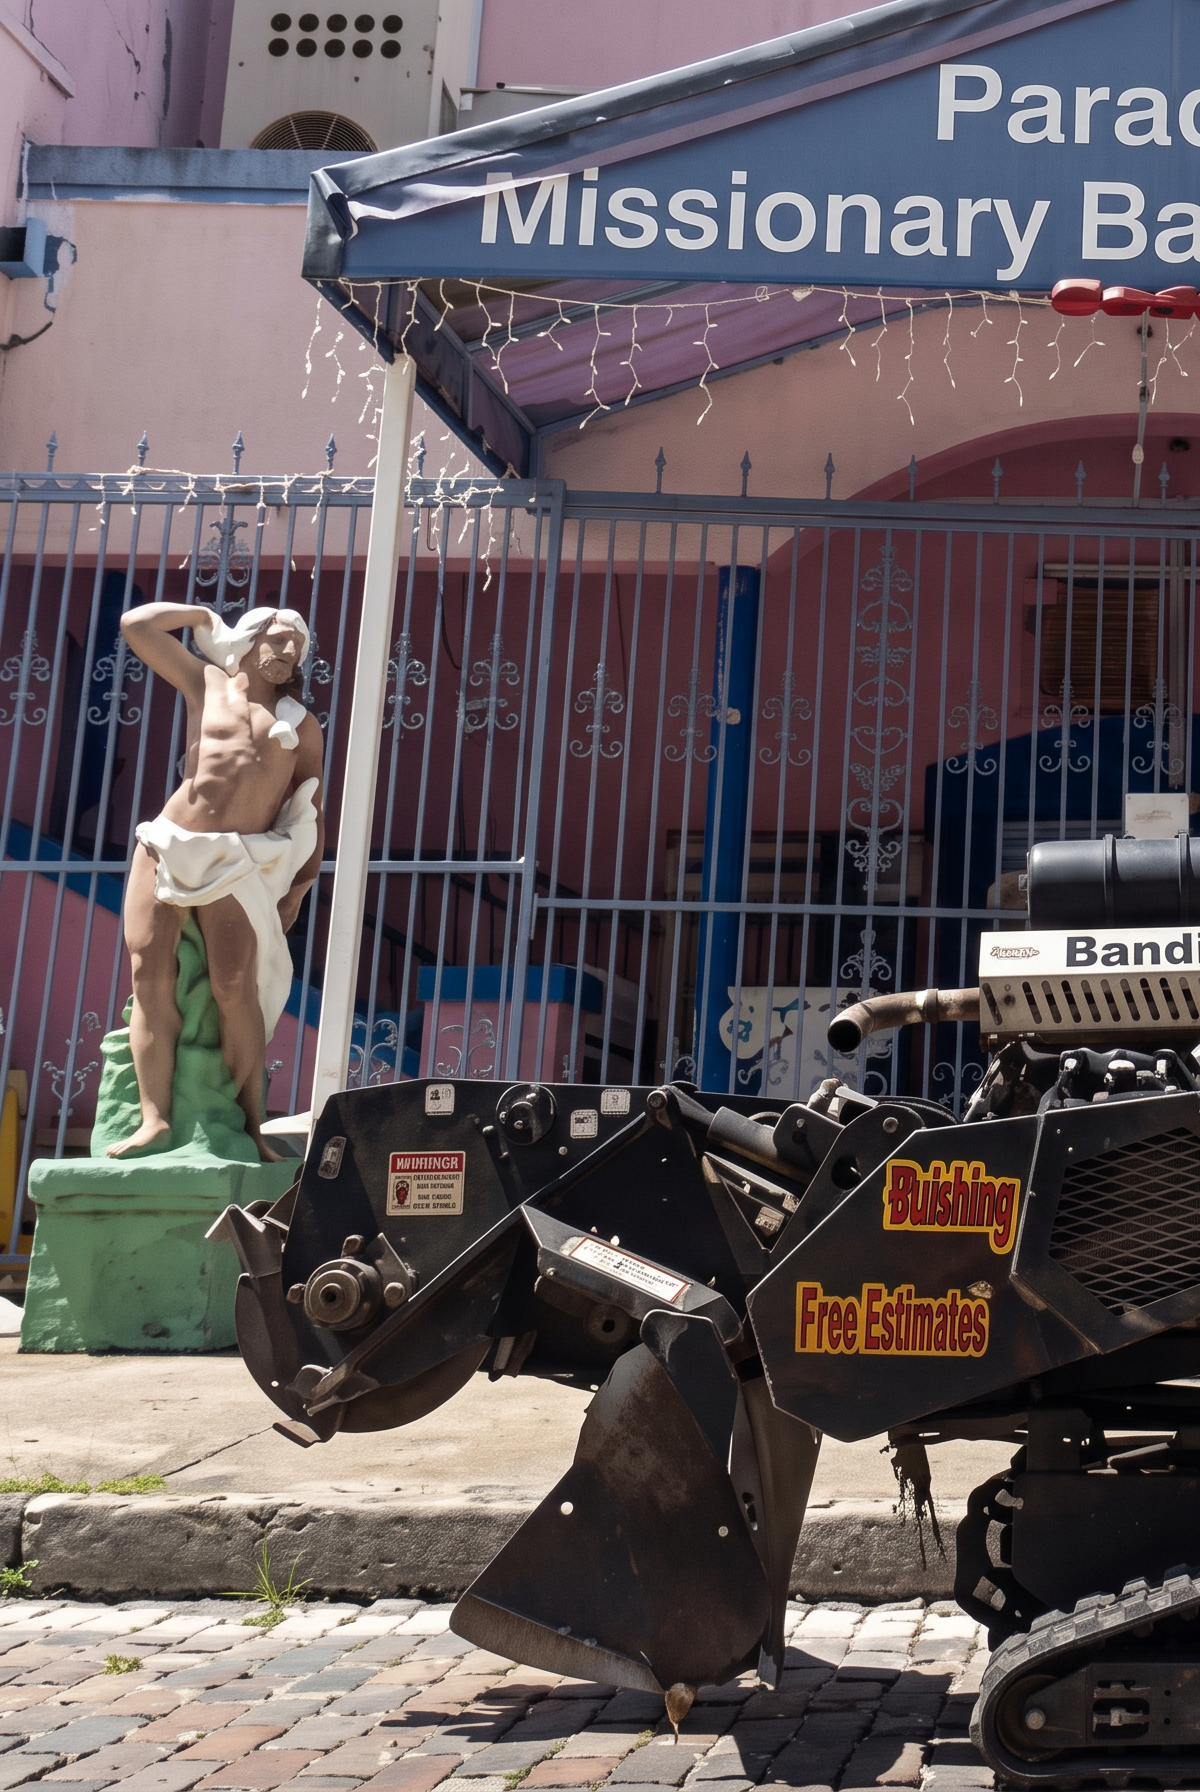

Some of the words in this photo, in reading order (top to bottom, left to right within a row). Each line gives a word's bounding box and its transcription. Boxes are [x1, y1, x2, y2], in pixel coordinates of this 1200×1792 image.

[480, 168, 1050, 281] Missionary
[800, 1287, 858, 1350] Free
[864, 1288, 987, 1352] Estimates
